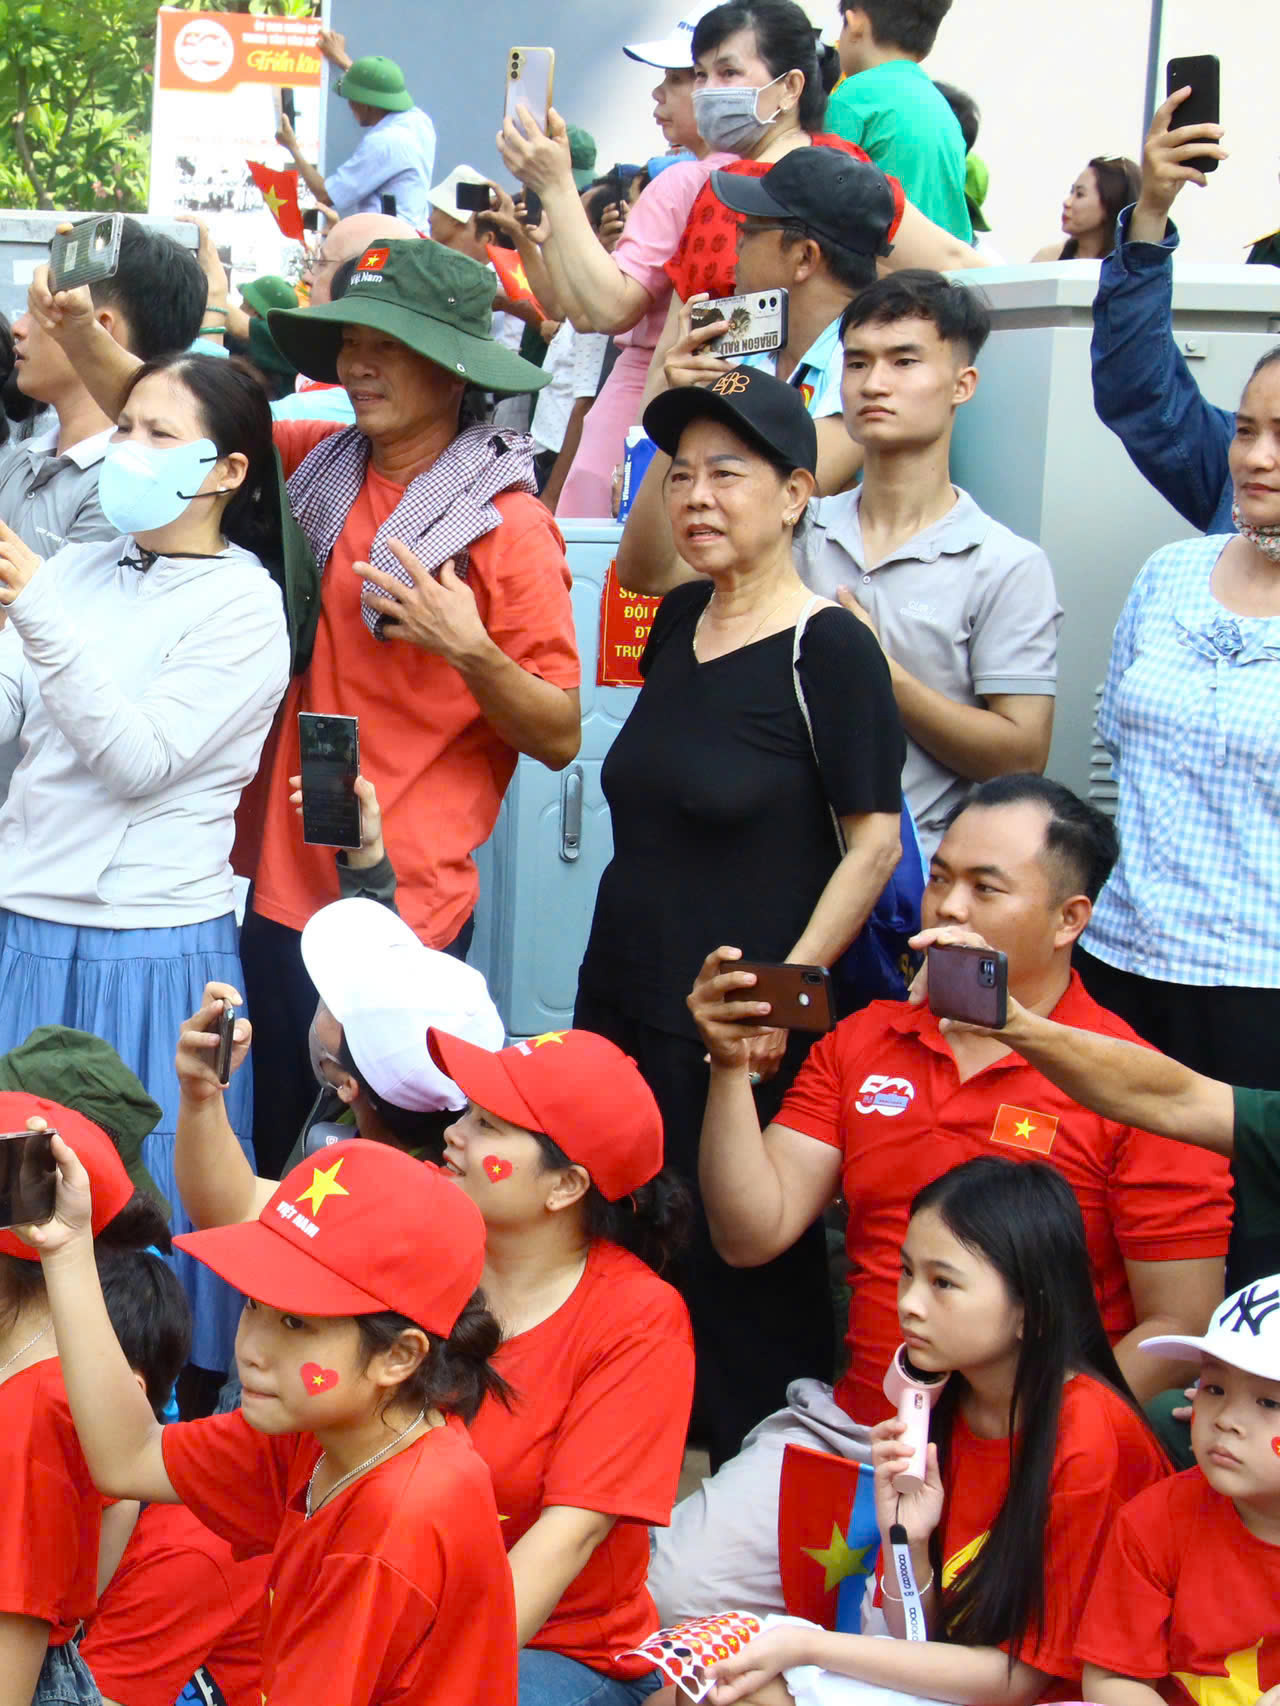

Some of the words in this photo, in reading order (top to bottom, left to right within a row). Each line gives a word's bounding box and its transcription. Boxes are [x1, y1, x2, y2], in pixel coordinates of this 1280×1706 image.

[741, 334, 779, 351] DRAGON
[622, 461, 632, 501] Vinamilk
[624, 603, 649, 621] ĐỘI
[855, 1074, 915, 1116] 50
[291, 1213, 321, 1239] NAM
